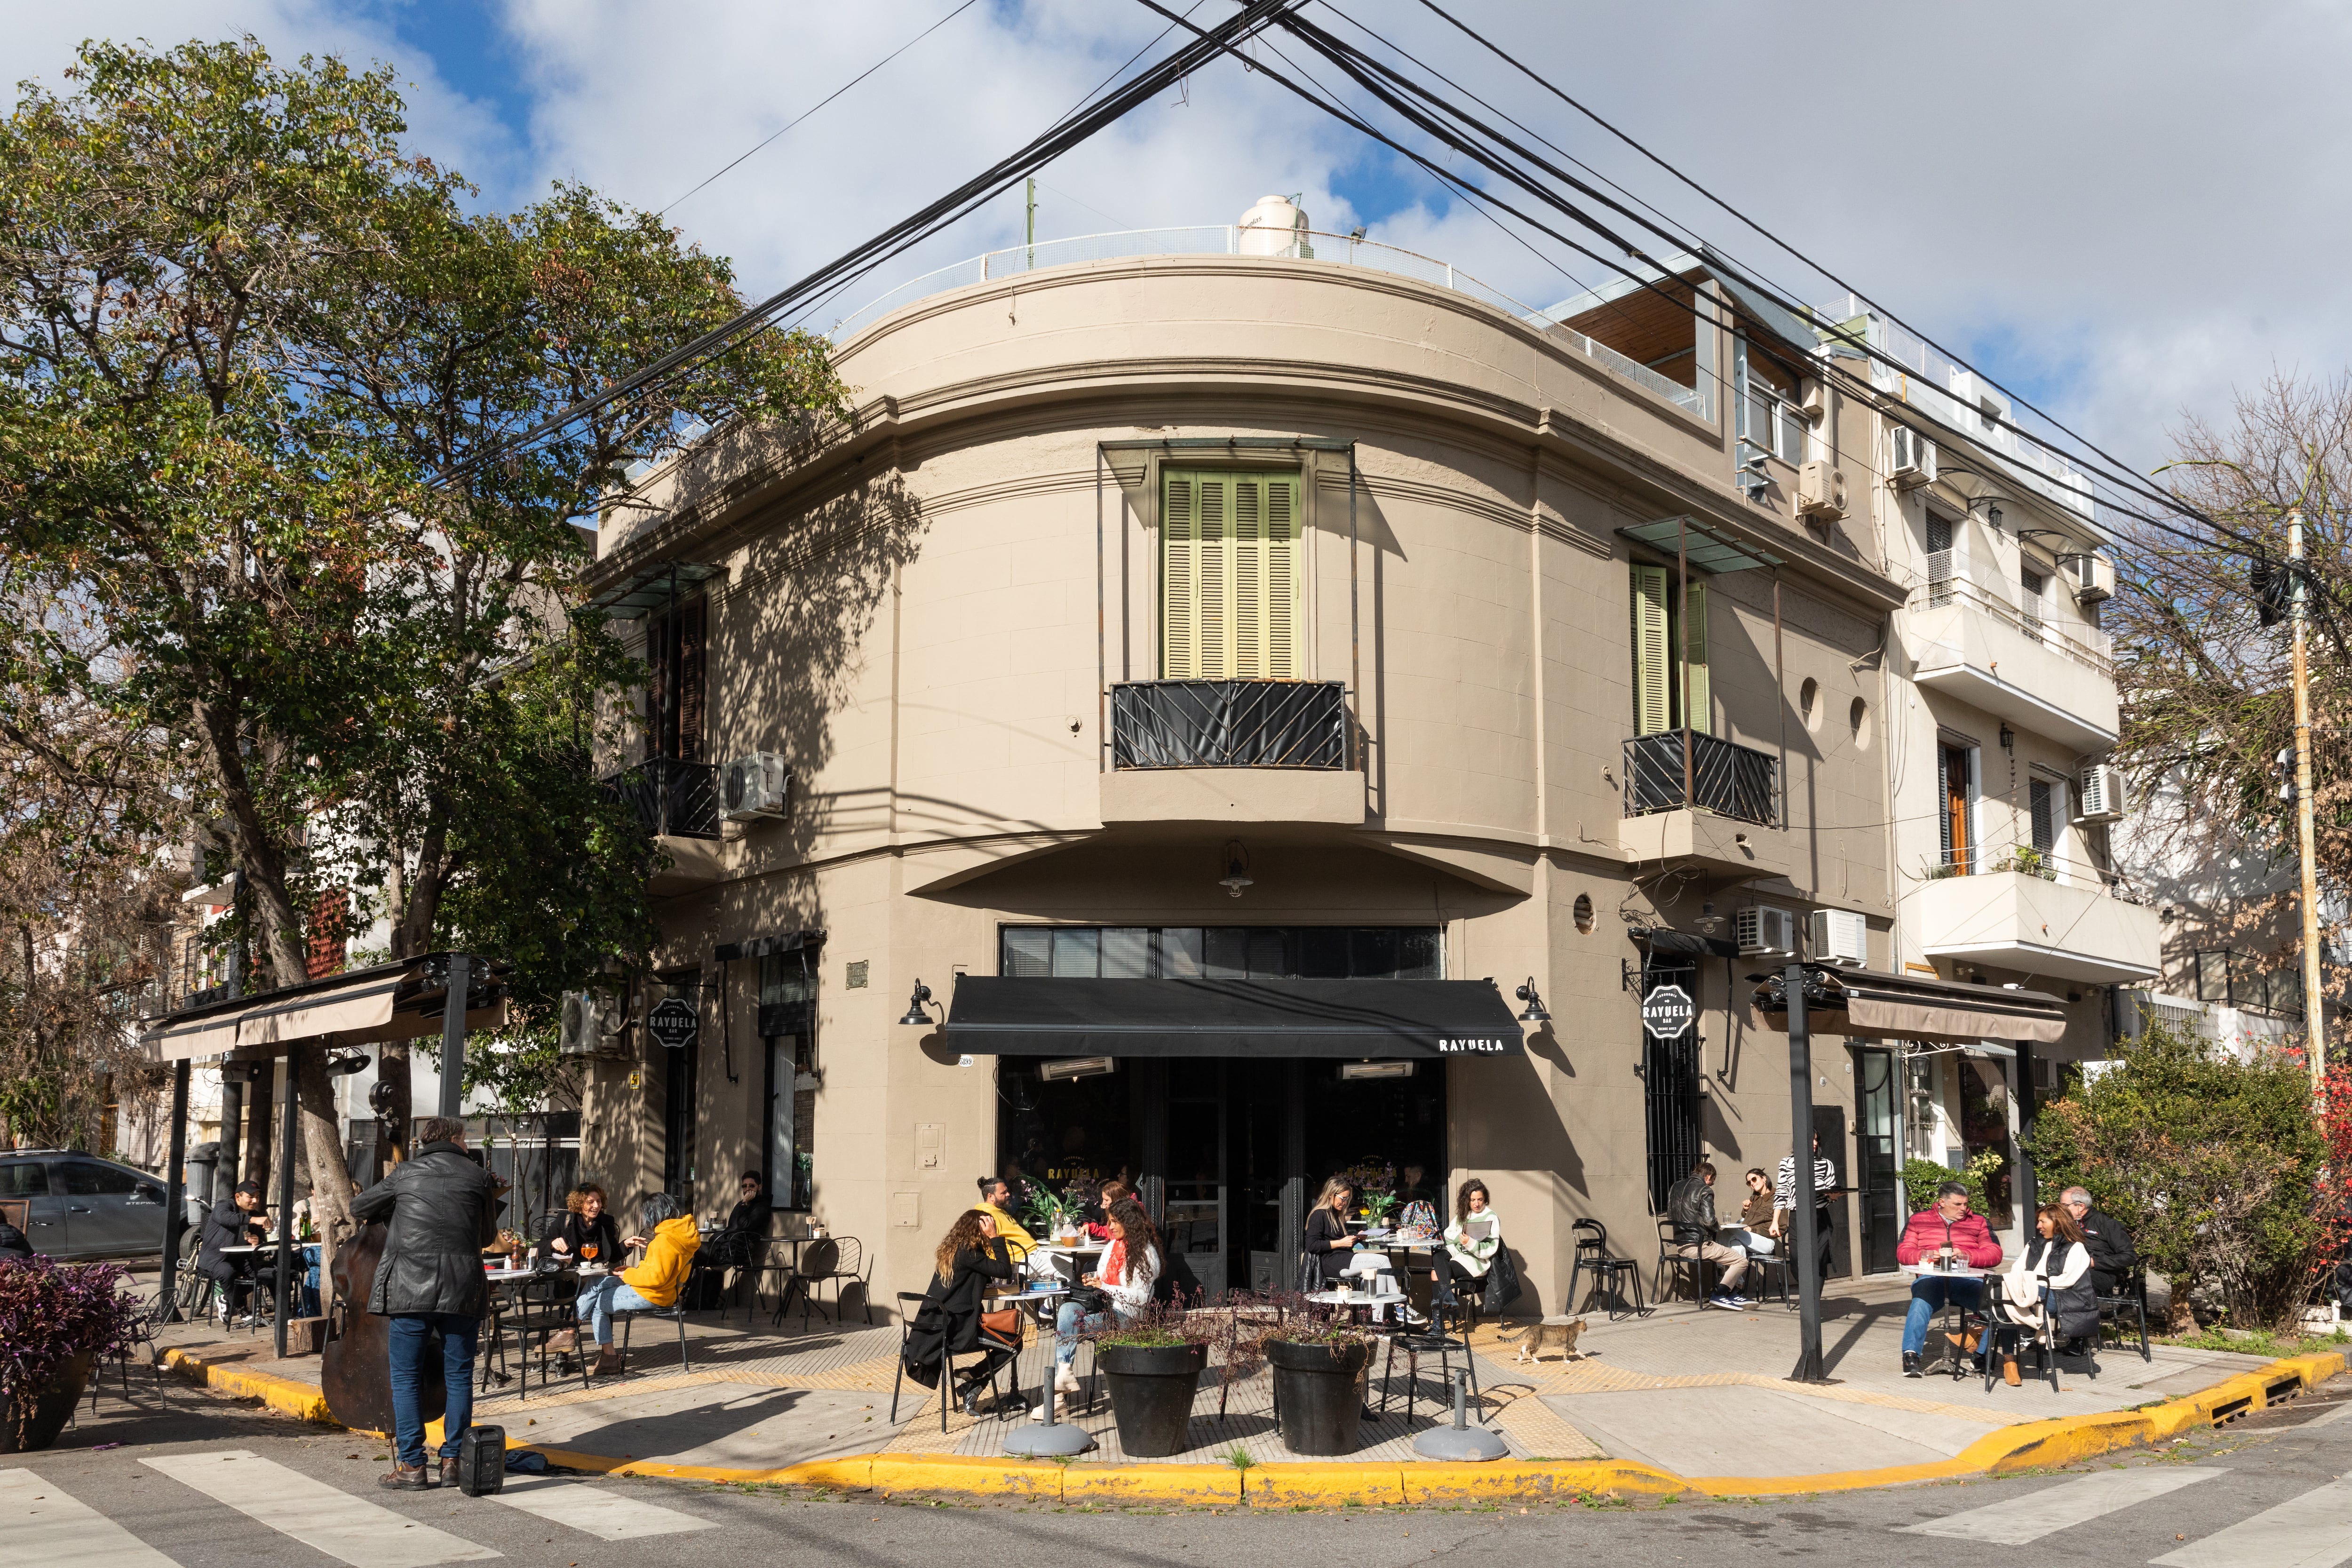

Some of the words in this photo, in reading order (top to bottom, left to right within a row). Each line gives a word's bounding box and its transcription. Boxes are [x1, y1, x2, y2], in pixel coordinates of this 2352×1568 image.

[1643, 1005, 1692, 1018] RAYUELA
[649, 1017, 697, 1028] RAYUELA
[1439, 1039, 1503, 1051] RAYUELA
